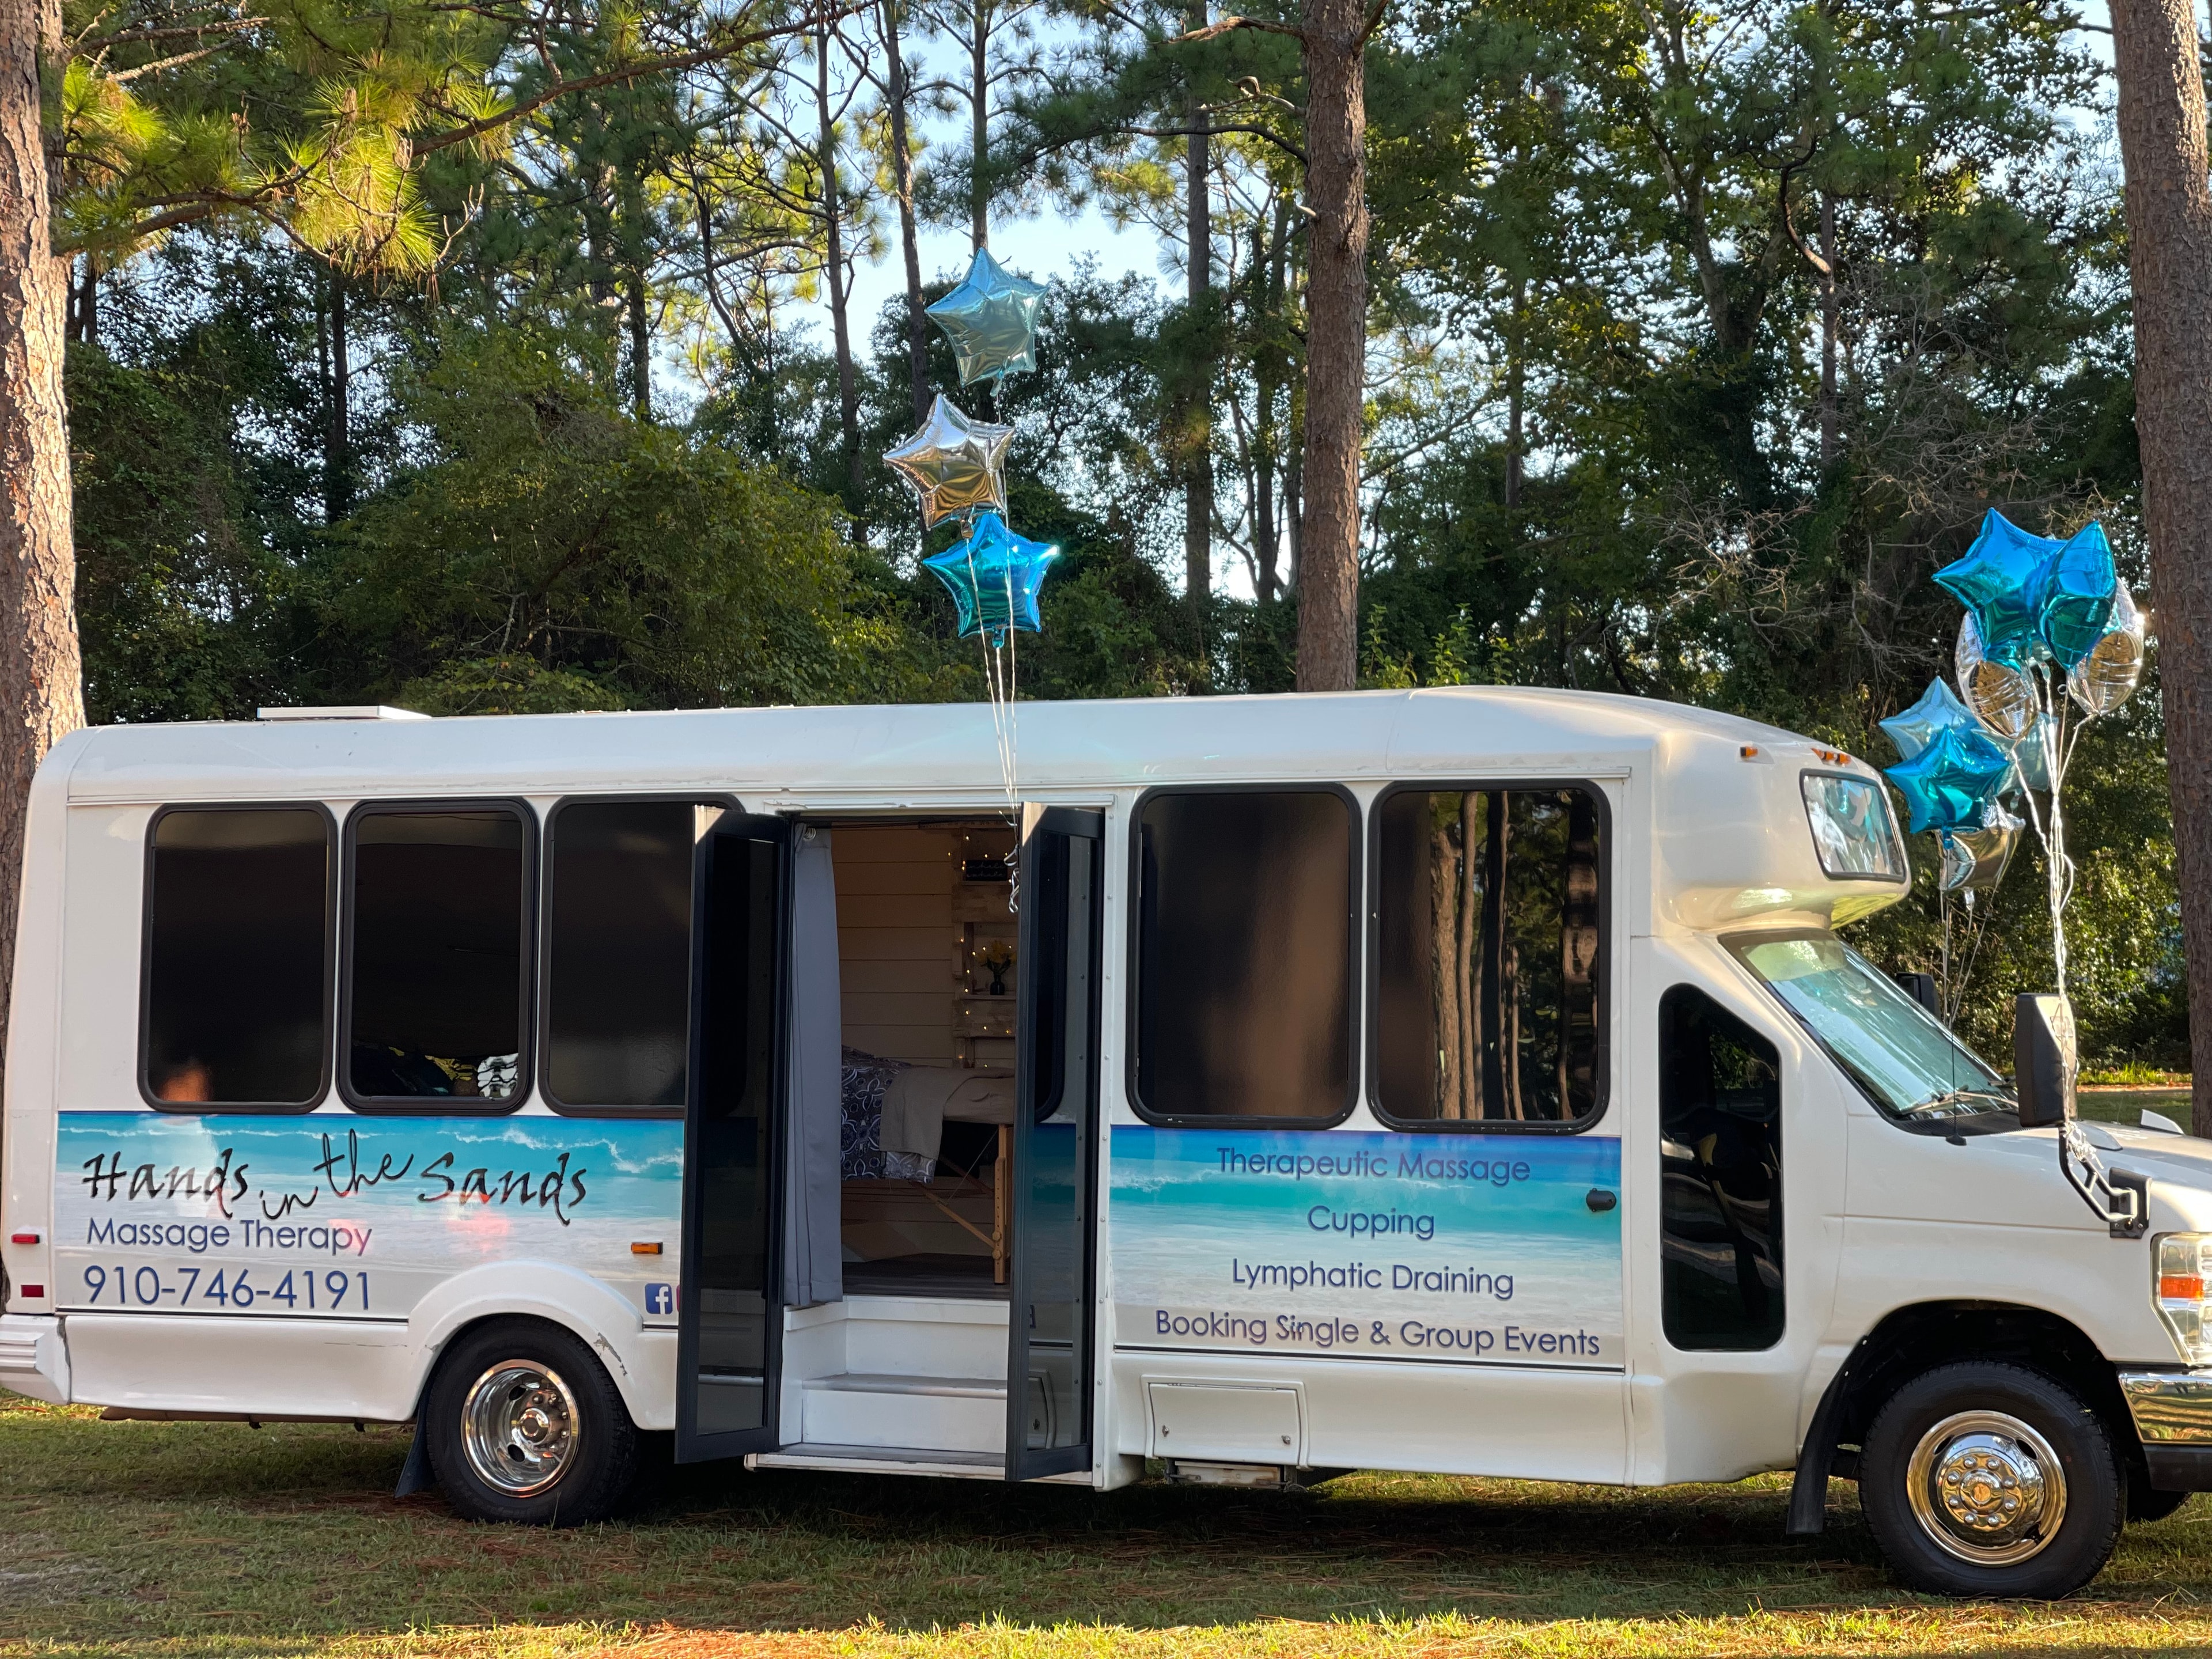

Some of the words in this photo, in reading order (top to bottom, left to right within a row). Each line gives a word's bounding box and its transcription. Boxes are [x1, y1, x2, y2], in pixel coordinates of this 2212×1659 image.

[82, 1148, 249, 1219] Hands
[257, 1186, 318, 1219] in
[313, 1128, 414, 1196] the
[418, 1152, 587, 1226] Sands
[1217, 1147, 1387, 1180] Therapeutic
[1397, 1153, 1530, 1187] Massage
[86, 1217, 230, 1252] Massage
[239, 1219, 373, 1256] Therapy
[1308, 1205, 1434, 1241] Cupping
[84, 1265, 369, 1310] 910-746-4191
[1232, 1258, 1382, 1290] Lymphatic
[1392, 1264, 1514, 1300] Draining
[1156, 1309, 1267, 1344] Booking
[1275, 1315, 1359, 1348] Single
[1370, 1320, 1392, 1345] &
[1400, 1320, 1494, 1355] Group
[1504, 1325, 1600, 1356] Events
